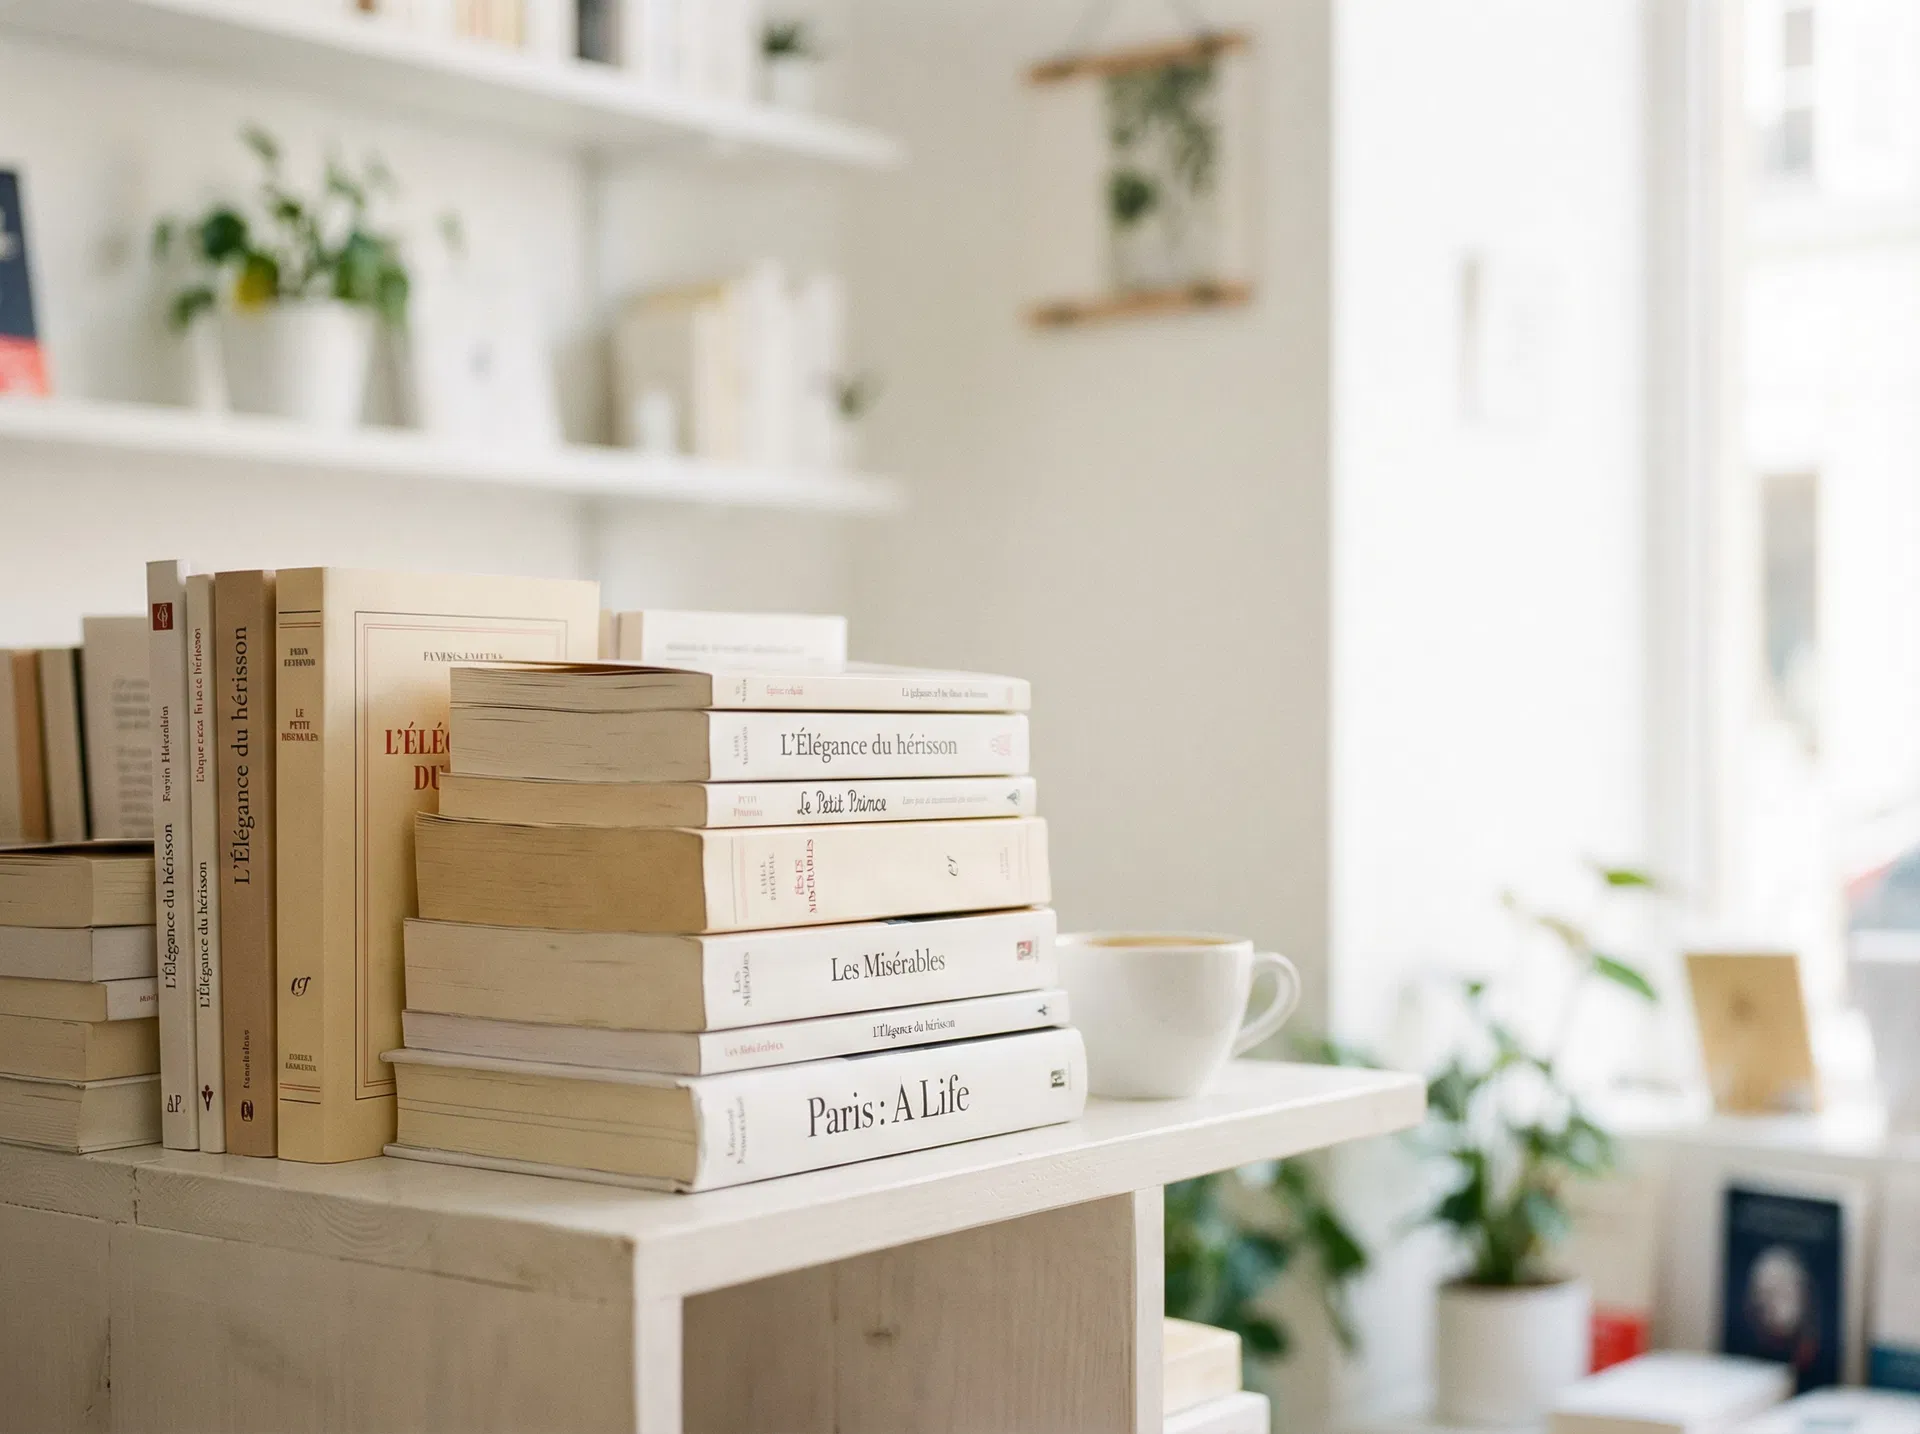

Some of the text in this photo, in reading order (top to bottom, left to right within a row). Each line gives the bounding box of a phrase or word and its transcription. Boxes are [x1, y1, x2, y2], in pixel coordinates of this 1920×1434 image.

[230, 627, 255, 884] L'Élégance du hérisson
[780, 727, 958, 763] L'Élégance du hérisson
[797, 791, 812, 815] Le
[816, 790, 844, 815] Petit
[848, 789, 887, 814] Prince
[162, 824, 174, 885] hérisson
[163, 890, 174, 908] du
[196, 862, 213, 1008] L'Élégance du hérisson
[831, 948, 945, 982] Les Misérables
[913, 1021, 924, 1033] du
[892, 1084, 915, 1124] A
[919, 1073, 971, 1119] Life
